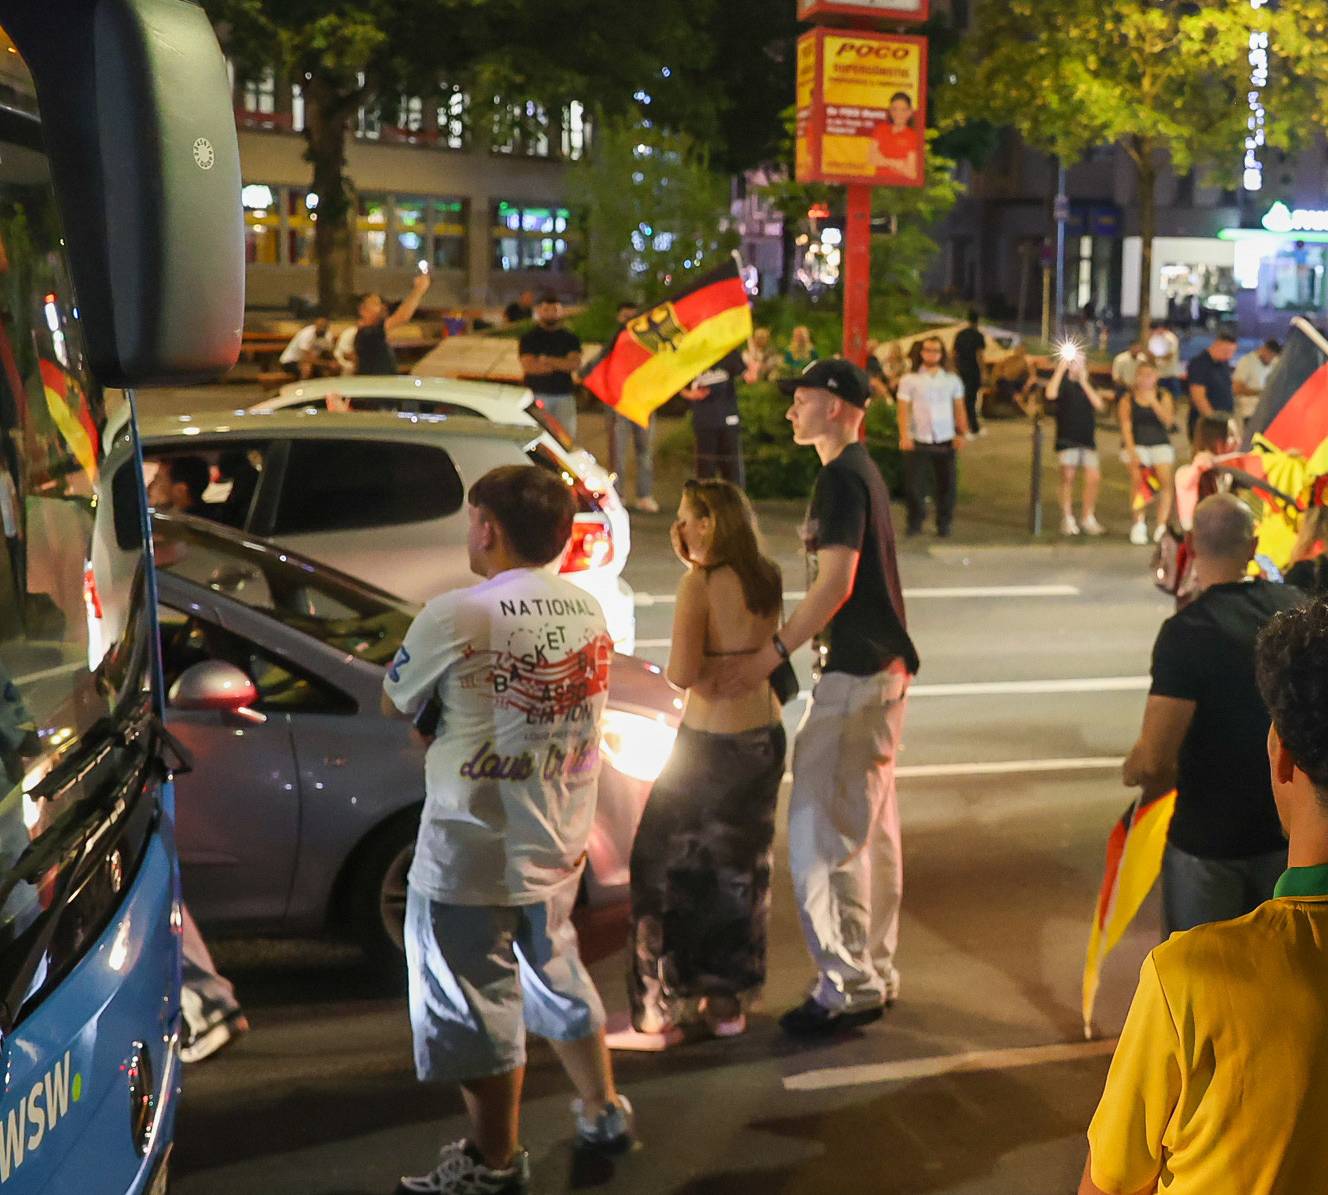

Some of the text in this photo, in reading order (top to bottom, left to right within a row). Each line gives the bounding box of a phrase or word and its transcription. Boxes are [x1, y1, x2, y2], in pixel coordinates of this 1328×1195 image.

[836, 42, 909, 60] POCO
[500, 599, 595, 616] NATIONAL
[494, 626, 566, 693] BASKET
